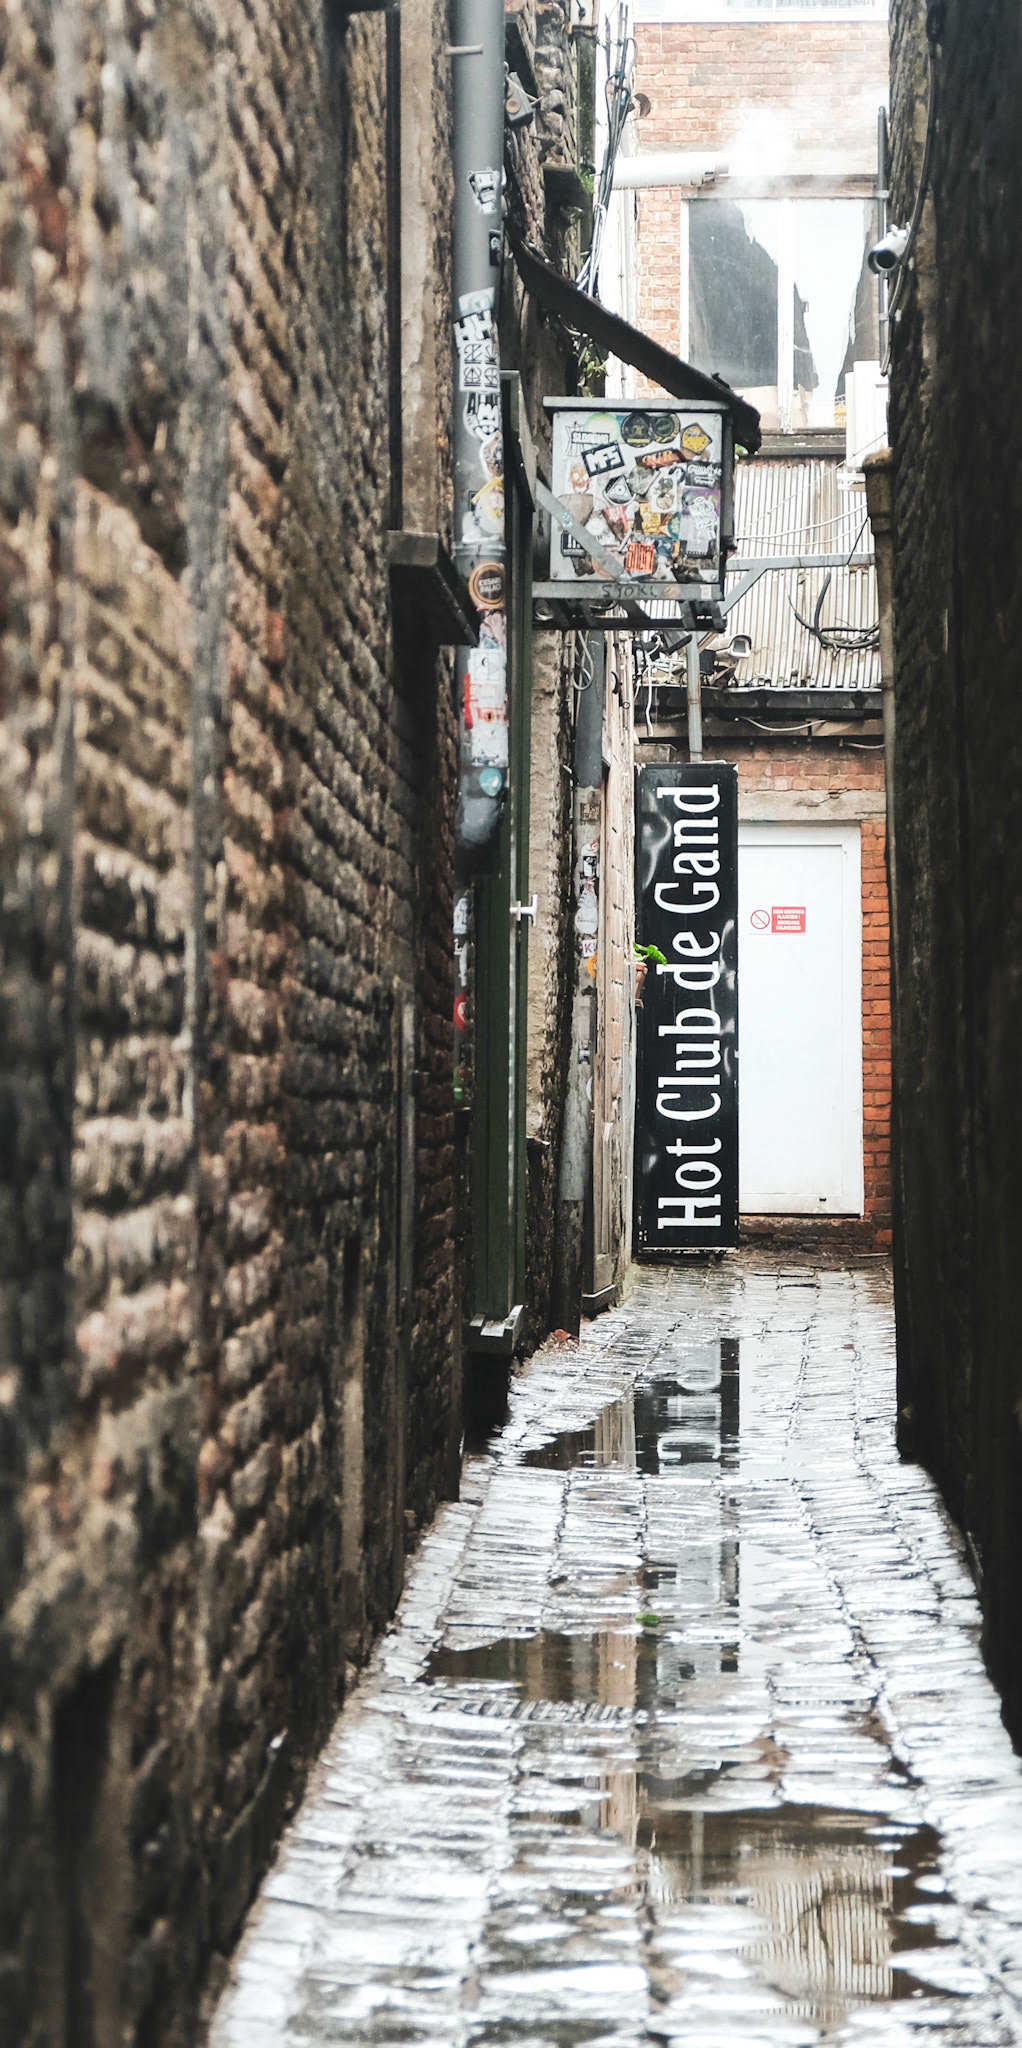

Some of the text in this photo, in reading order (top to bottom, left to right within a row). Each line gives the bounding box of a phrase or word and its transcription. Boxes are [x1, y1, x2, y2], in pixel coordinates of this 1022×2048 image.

[585, 445, 621, 472] MFS
[654, 784, 721, 1230] Hot Club de Gand
